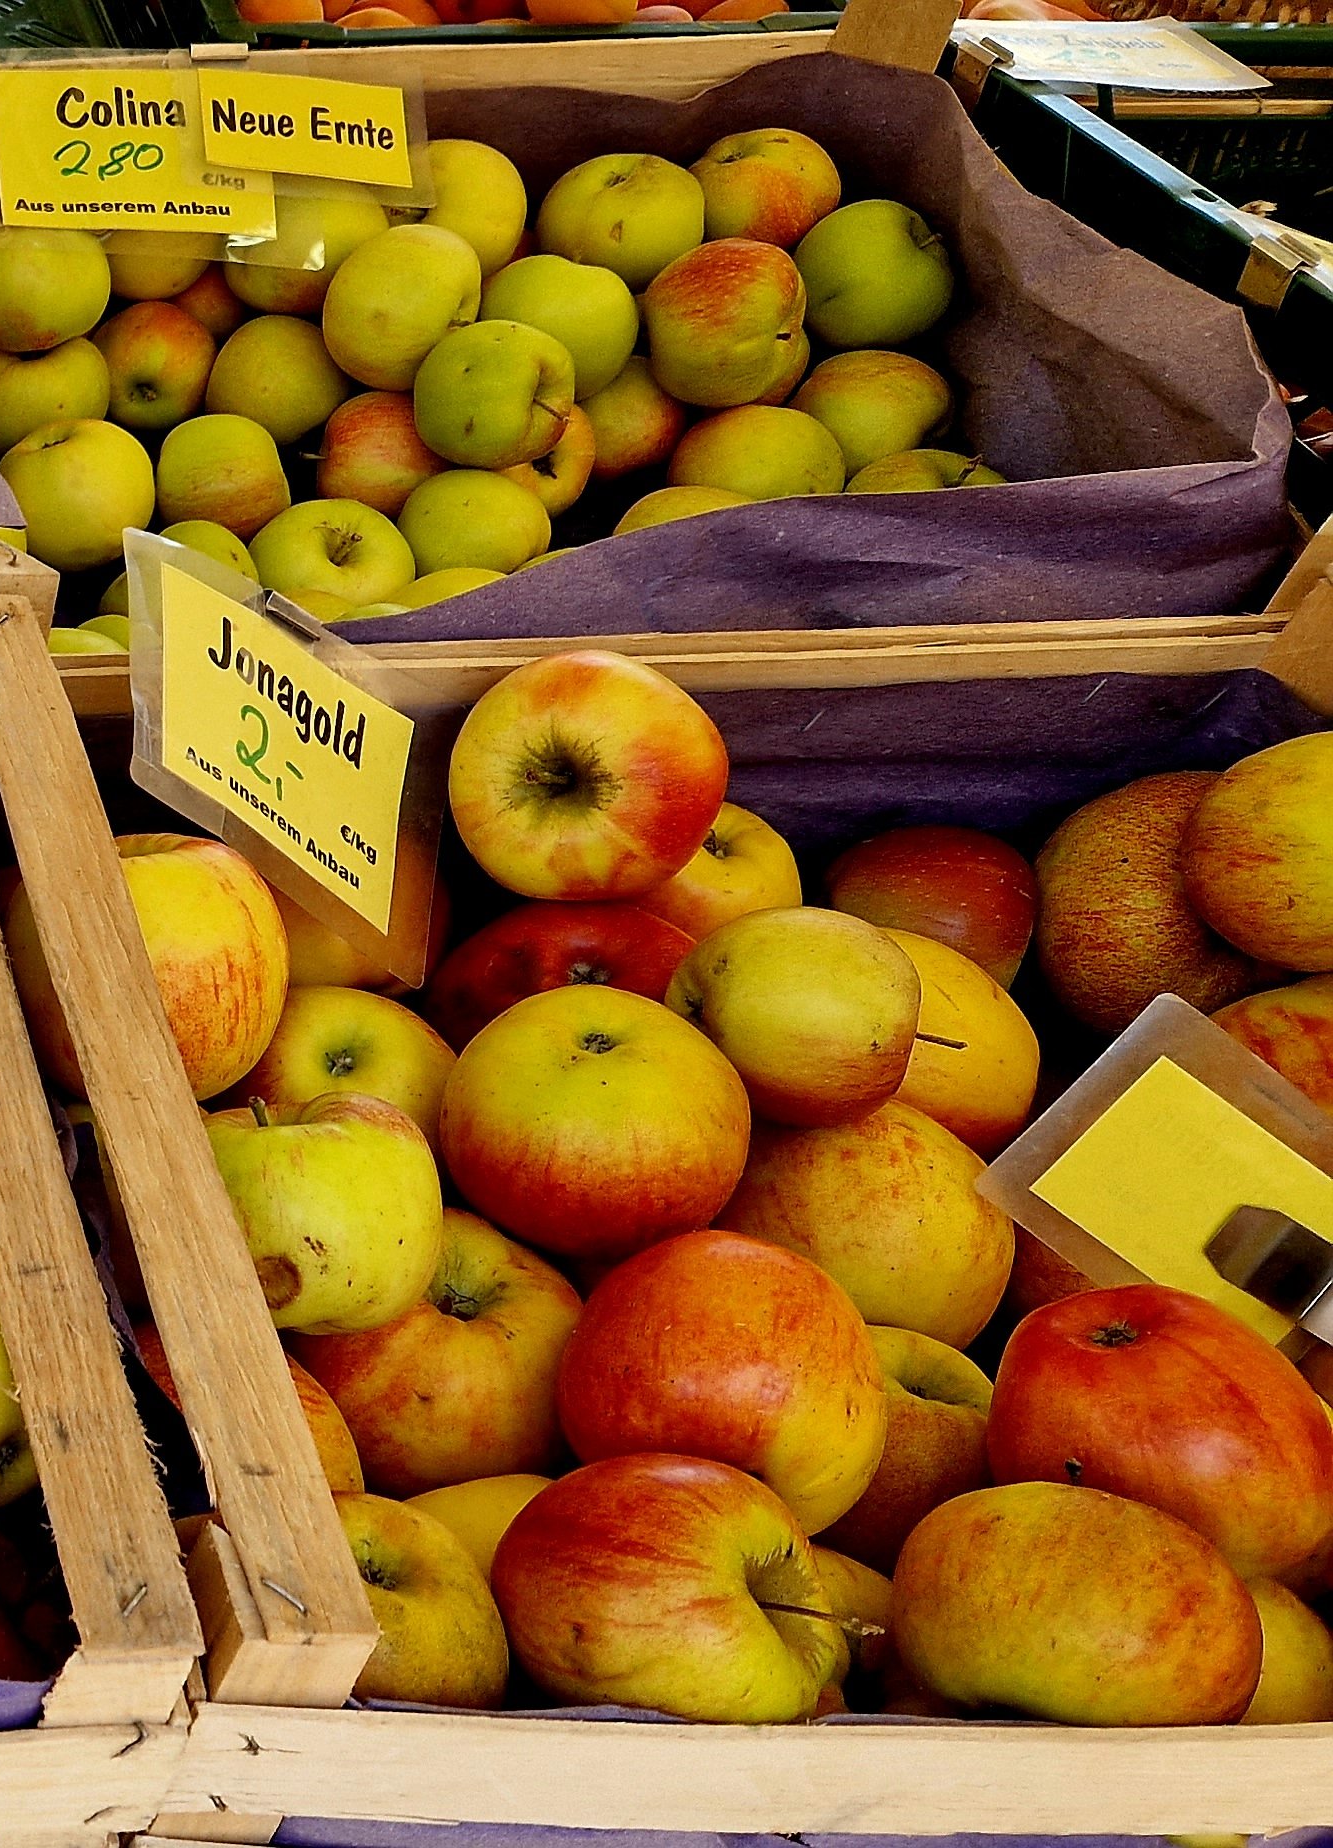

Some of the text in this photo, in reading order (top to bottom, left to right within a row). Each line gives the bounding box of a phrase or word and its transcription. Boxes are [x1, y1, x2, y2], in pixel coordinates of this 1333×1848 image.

[55, 86, 185, 129] Colina
[212, 98, 395, 151] Neue Ernte
[201, 173, 246, 191] €/kg
[14, 199, 231, 217] Aus unserem Anbau
[207, 615, 367, 770] Jonagold
[185, 746, 362, 890] Aus unserem Anbau
[339, 823, 379, 866] €/kg
